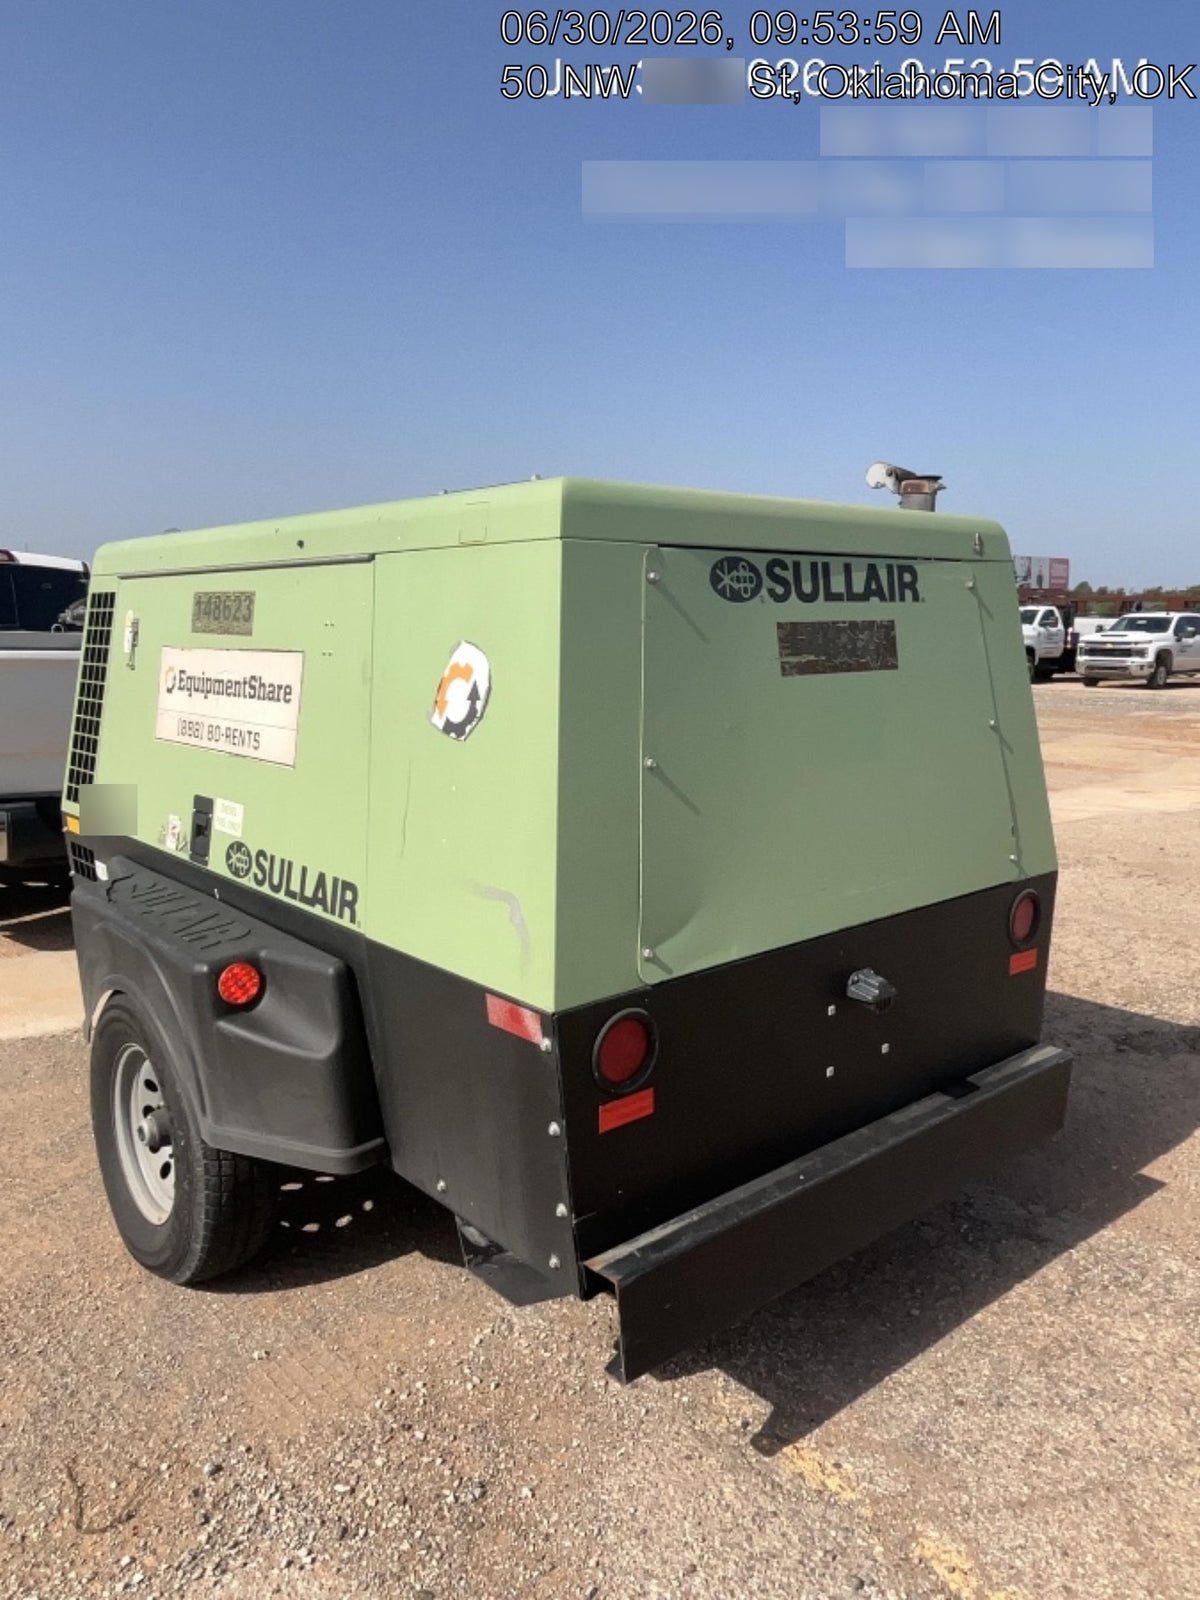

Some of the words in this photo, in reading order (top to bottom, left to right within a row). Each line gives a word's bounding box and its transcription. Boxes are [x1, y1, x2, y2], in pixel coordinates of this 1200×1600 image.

[765, 558, 921, 603] SULLAIR
[194, 594, 252, 623] 148623
[177, 669, 293, 704] EquipmentShare
[253, 848, 360, 925] SULLAIR
